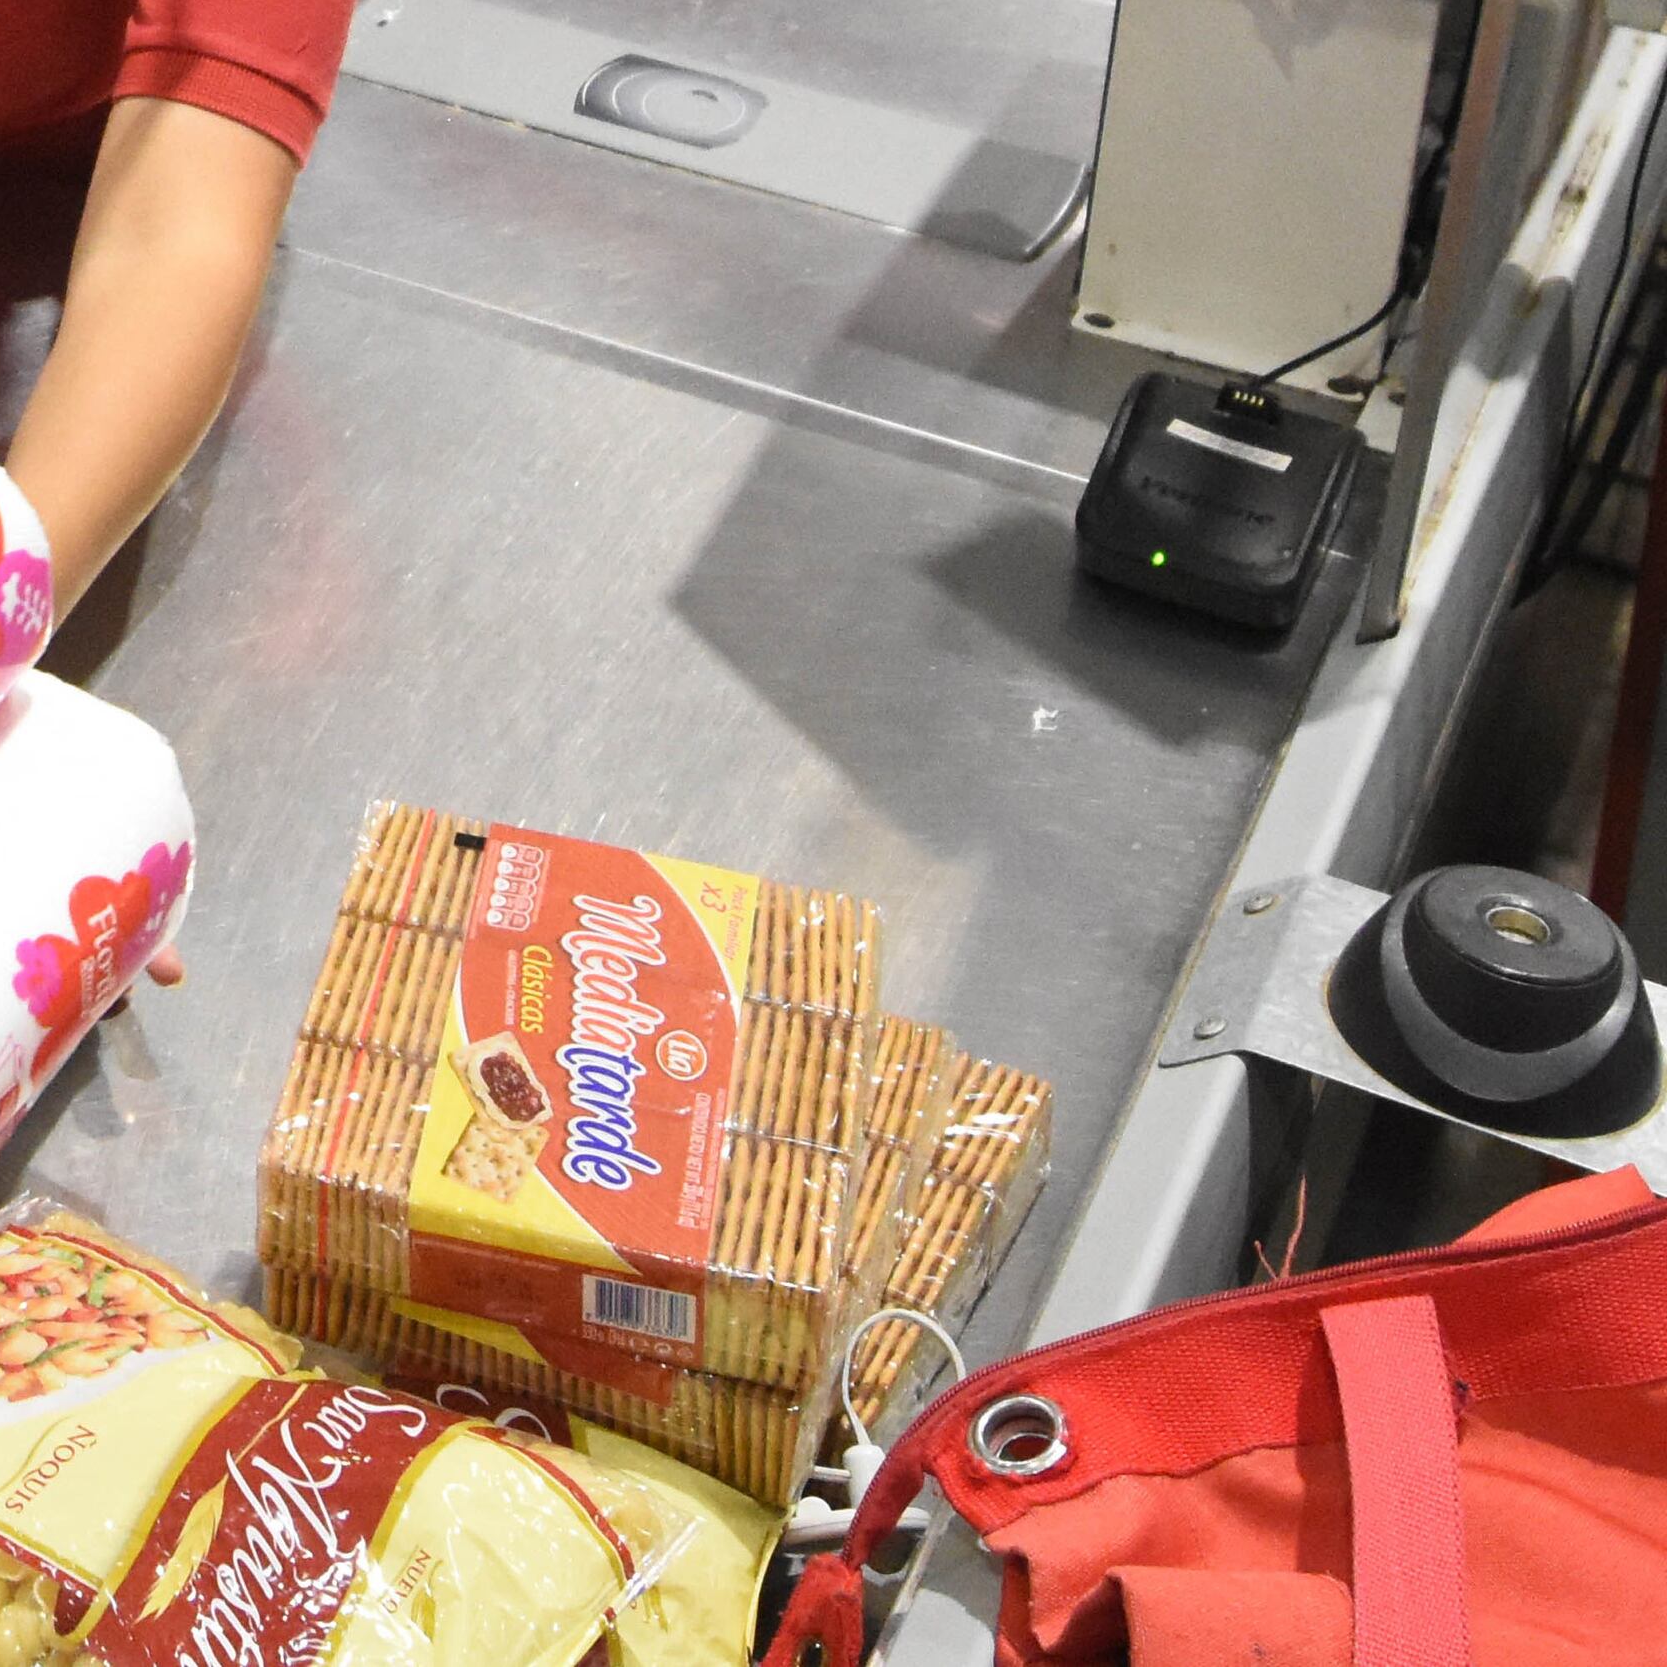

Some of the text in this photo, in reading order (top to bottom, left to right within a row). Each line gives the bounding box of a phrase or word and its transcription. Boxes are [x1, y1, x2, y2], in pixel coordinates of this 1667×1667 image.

[520, 944, 554, 1035] Clásicas
[303, 1385, 427, 1451] San
[4, 1423, 97, 1515] ÑOQUIS
